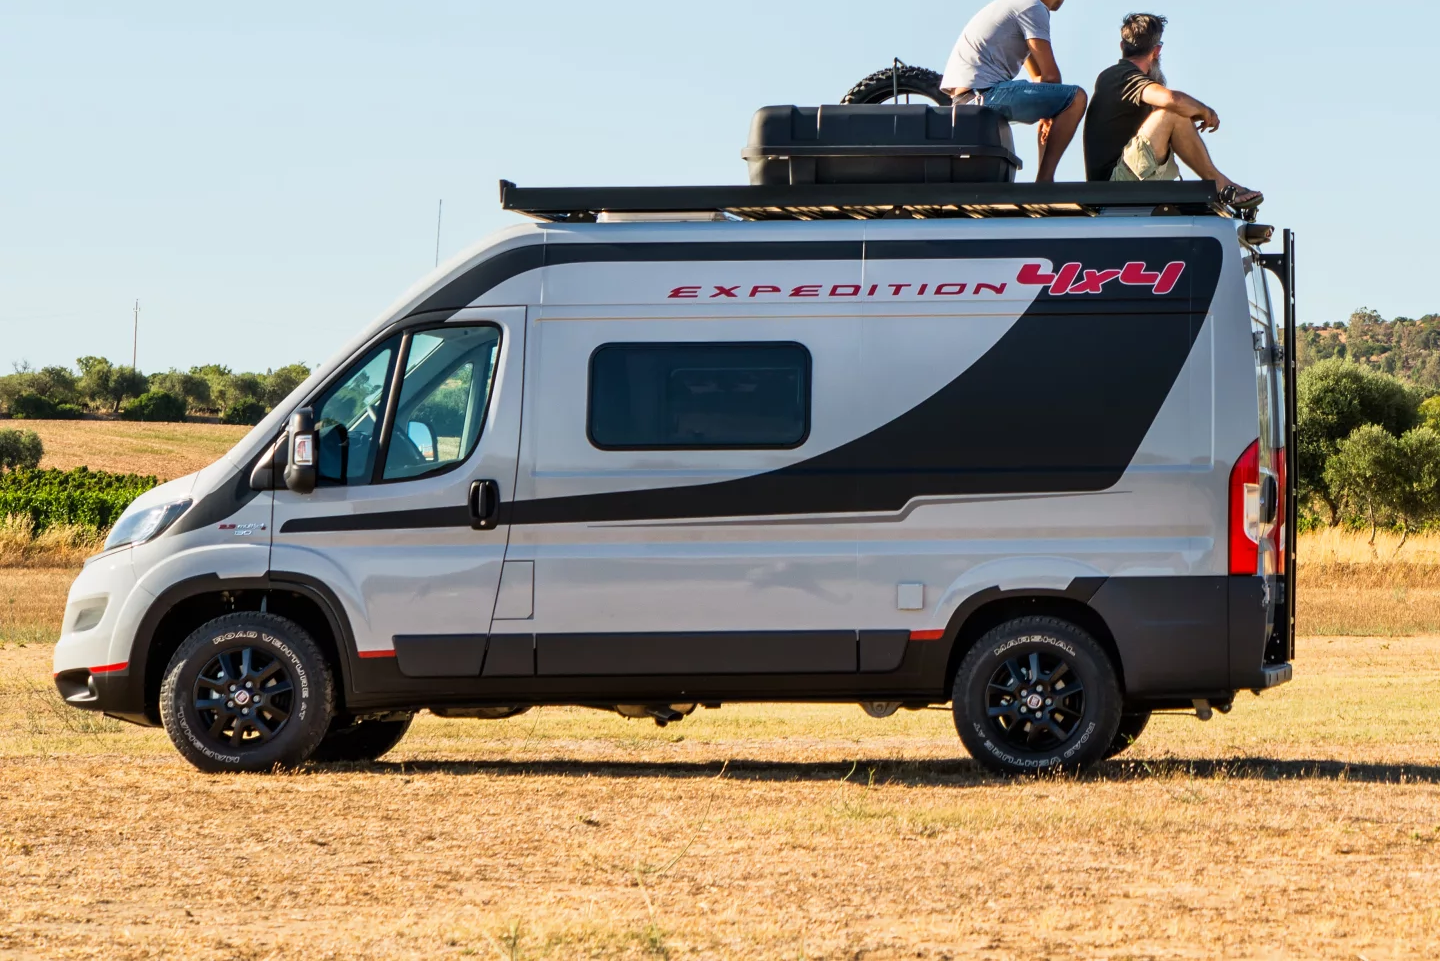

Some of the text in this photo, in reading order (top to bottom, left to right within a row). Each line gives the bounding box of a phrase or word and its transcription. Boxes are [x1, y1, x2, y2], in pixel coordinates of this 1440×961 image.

[668, 261, 1186, 299] EXPEDITION 4x4
[993, 634, 1076, 657] MARSHAL
[212, 630, 258, 645] ROAD
[262, 633, 309, 699] VENTURE
[177, 706, 240, 764] MARSHAL
[983, 739, 1061, 767] VENTURE
[1063, 721, 1096, 758] ROAD
